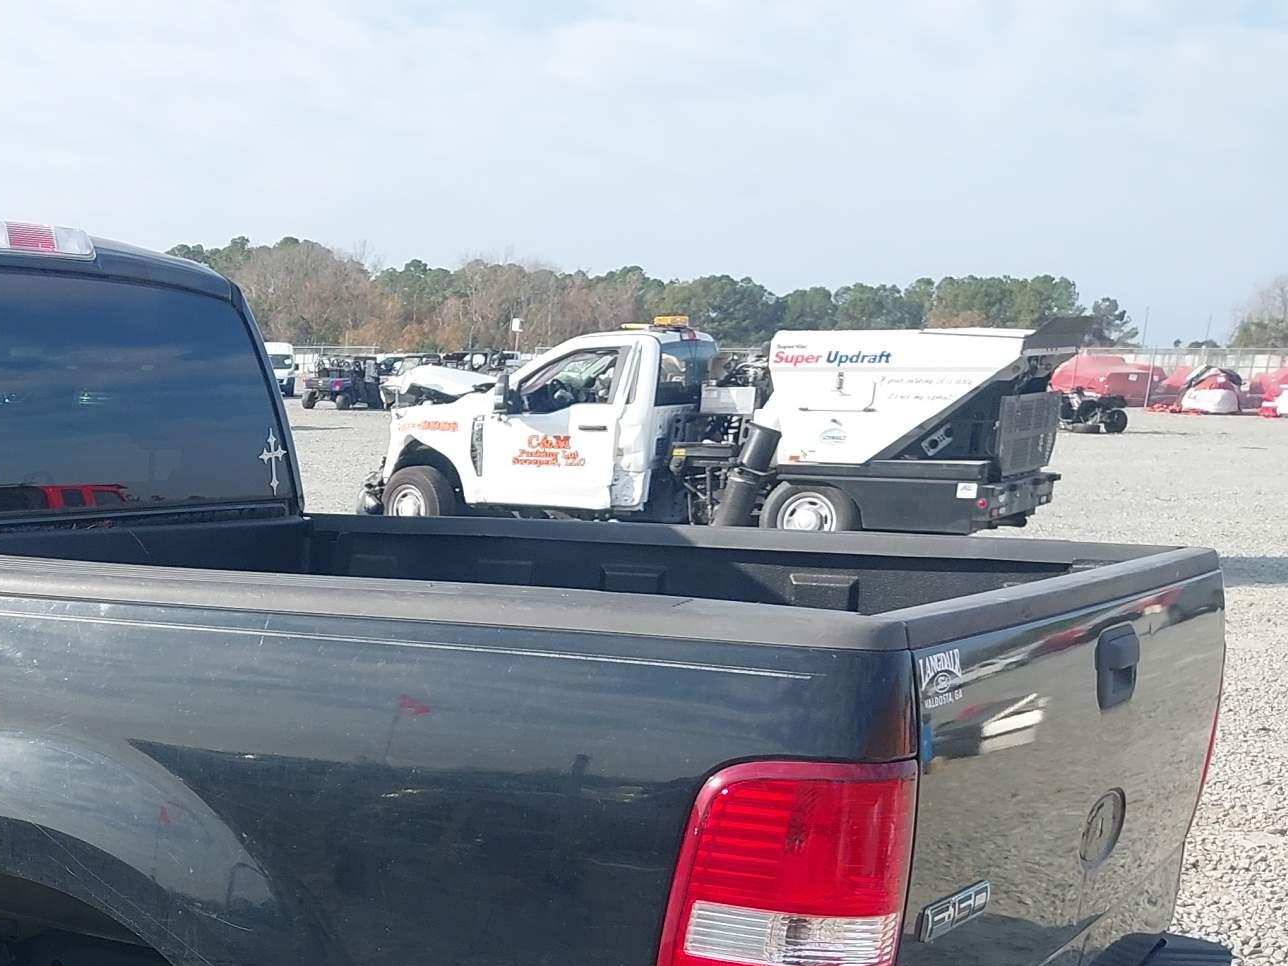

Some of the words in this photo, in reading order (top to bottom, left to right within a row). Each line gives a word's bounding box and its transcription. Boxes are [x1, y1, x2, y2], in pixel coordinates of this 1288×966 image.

[773, 351, 823, 366] Super
[825, 350, 892, 367] Updraft
[919, 648, 962, 691] LANGDALE
